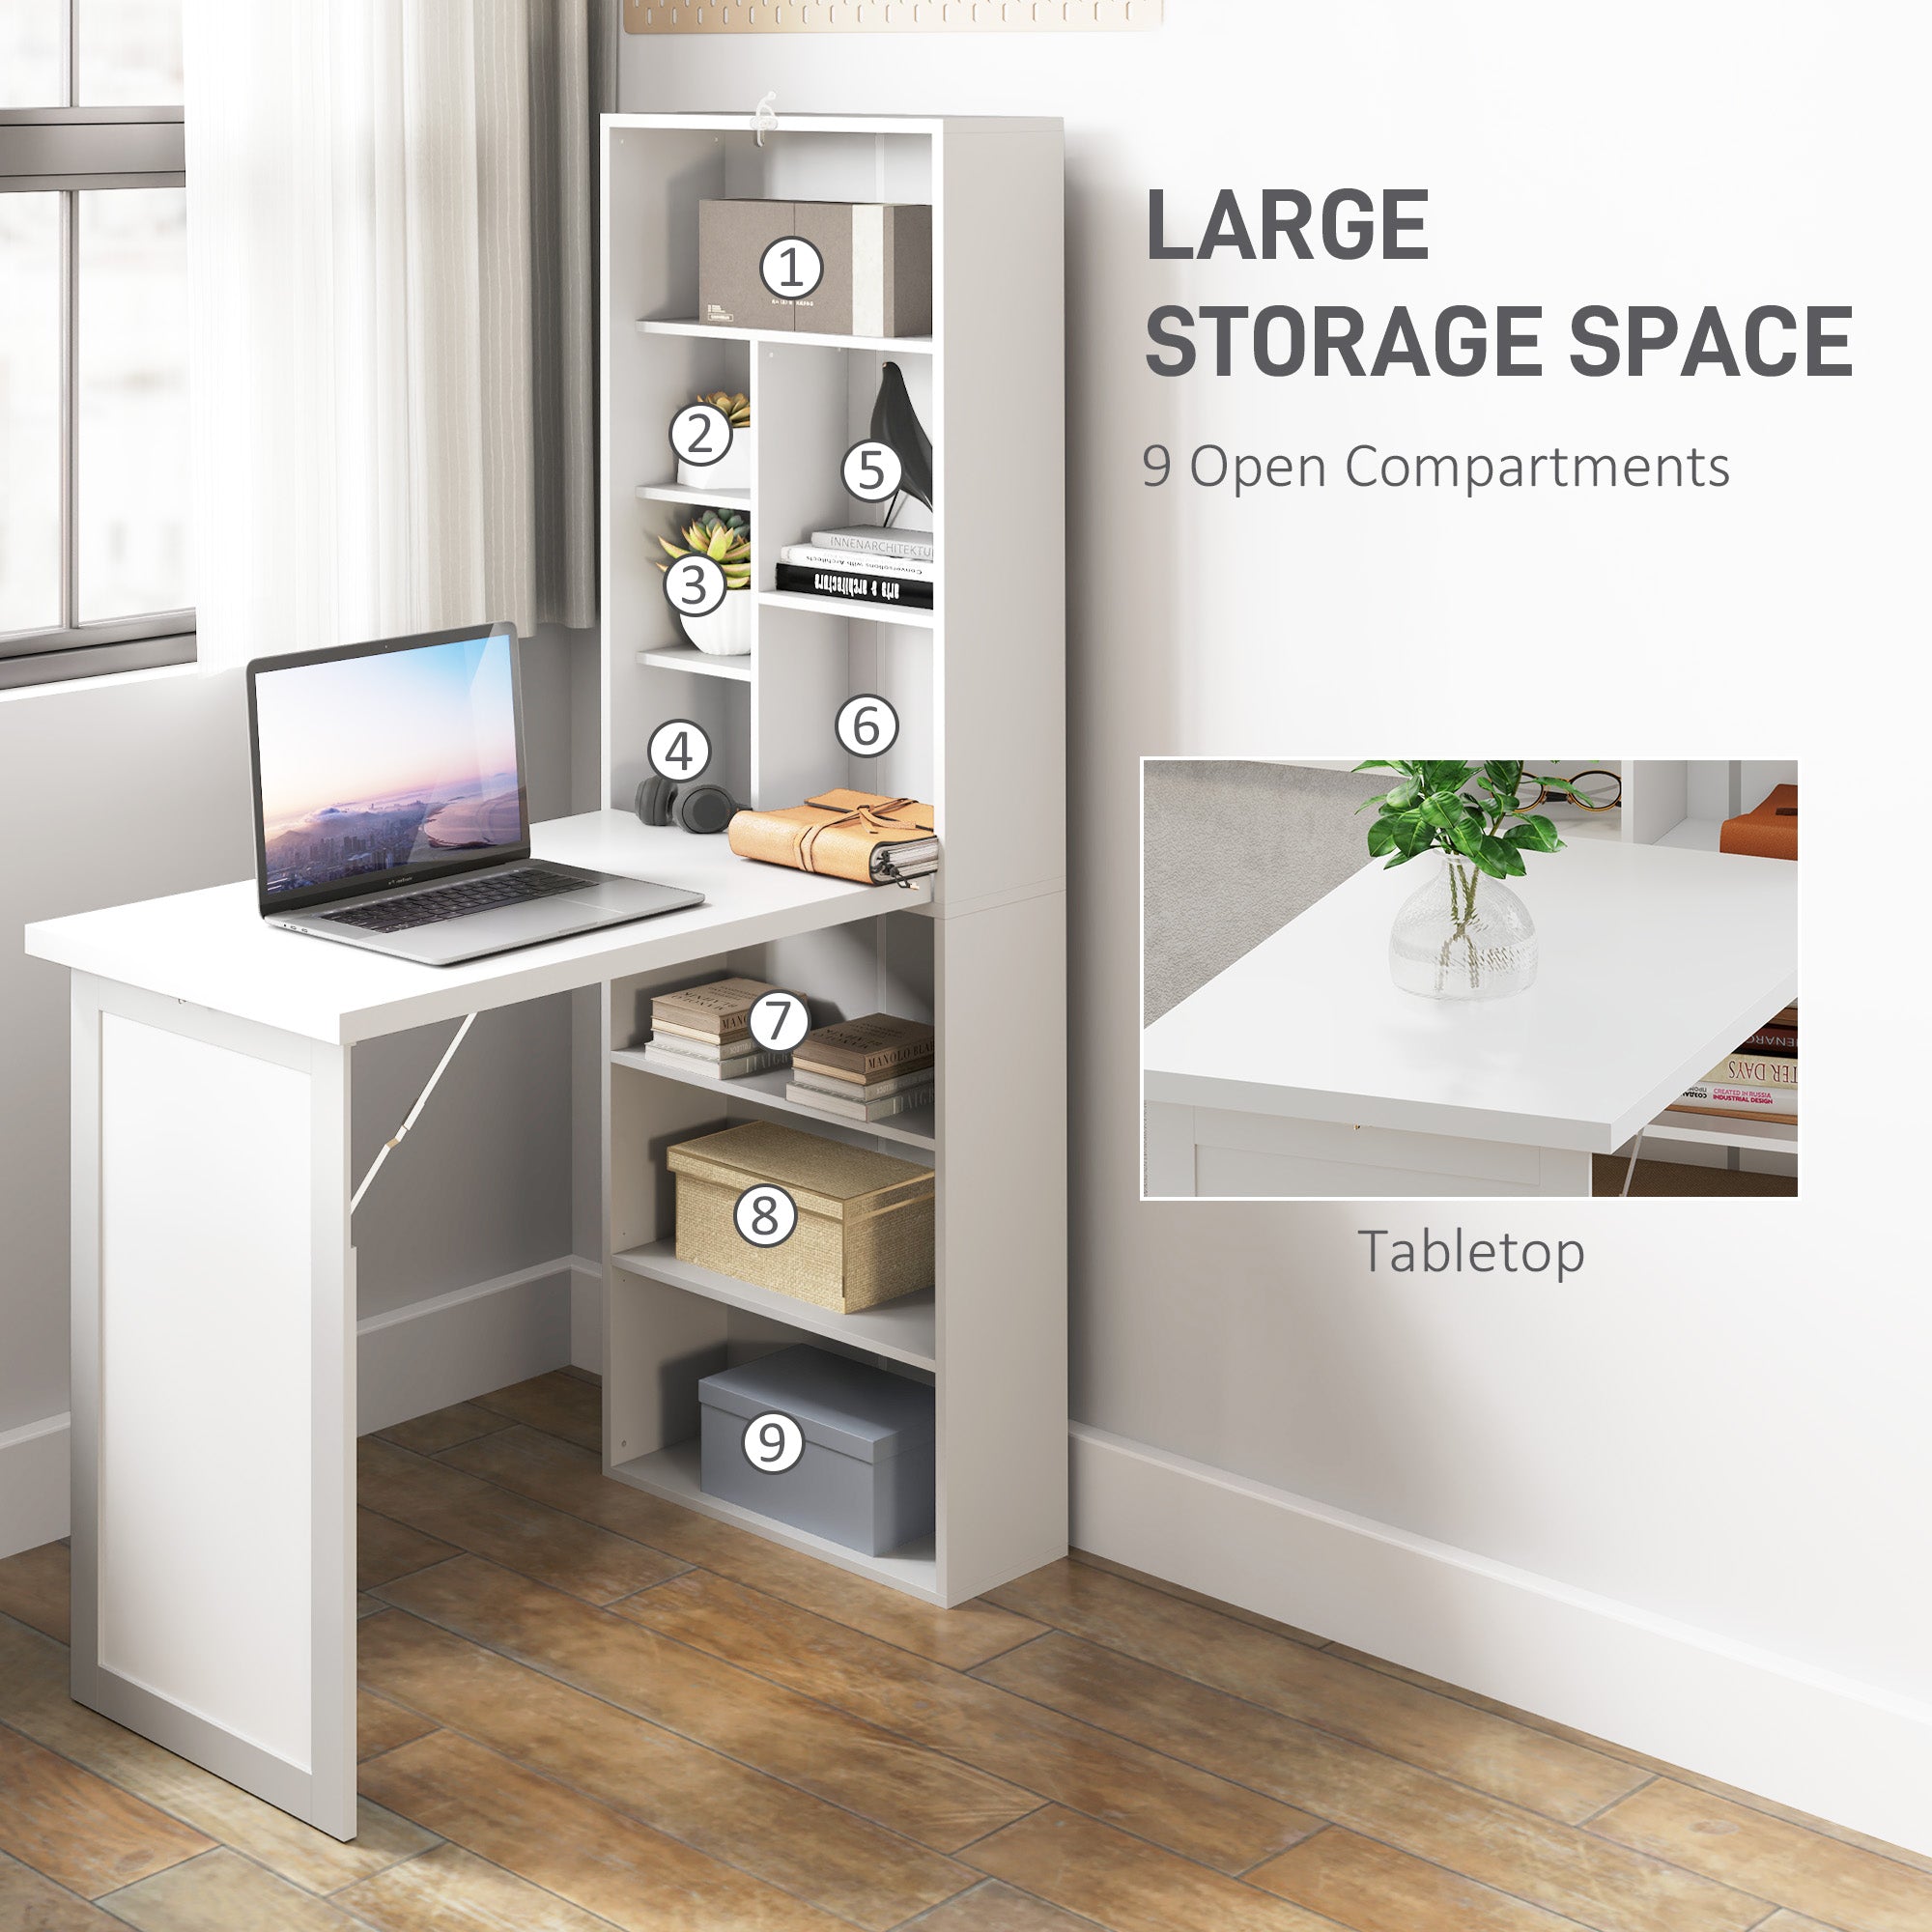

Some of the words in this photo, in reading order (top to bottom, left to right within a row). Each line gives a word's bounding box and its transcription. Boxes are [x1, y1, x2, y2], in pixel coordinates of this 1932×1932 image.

[830, 535, 933, 557] INNENARCHITEKTU
[806, 555, 845, 567] Architects
[814, 573, 867, 597] architecture
[881, 582, 899, 600] arts
[1746, 1036, 1798, 1047] ENARC
[867, 1048, 911, 1068] MANOLO
[1728, 1060, 1766, 1081] DAYS
[1713, 1088, 1741, 1096] CREATED
[1713, 1094, 1749, 1103] INDUSTRIAL
